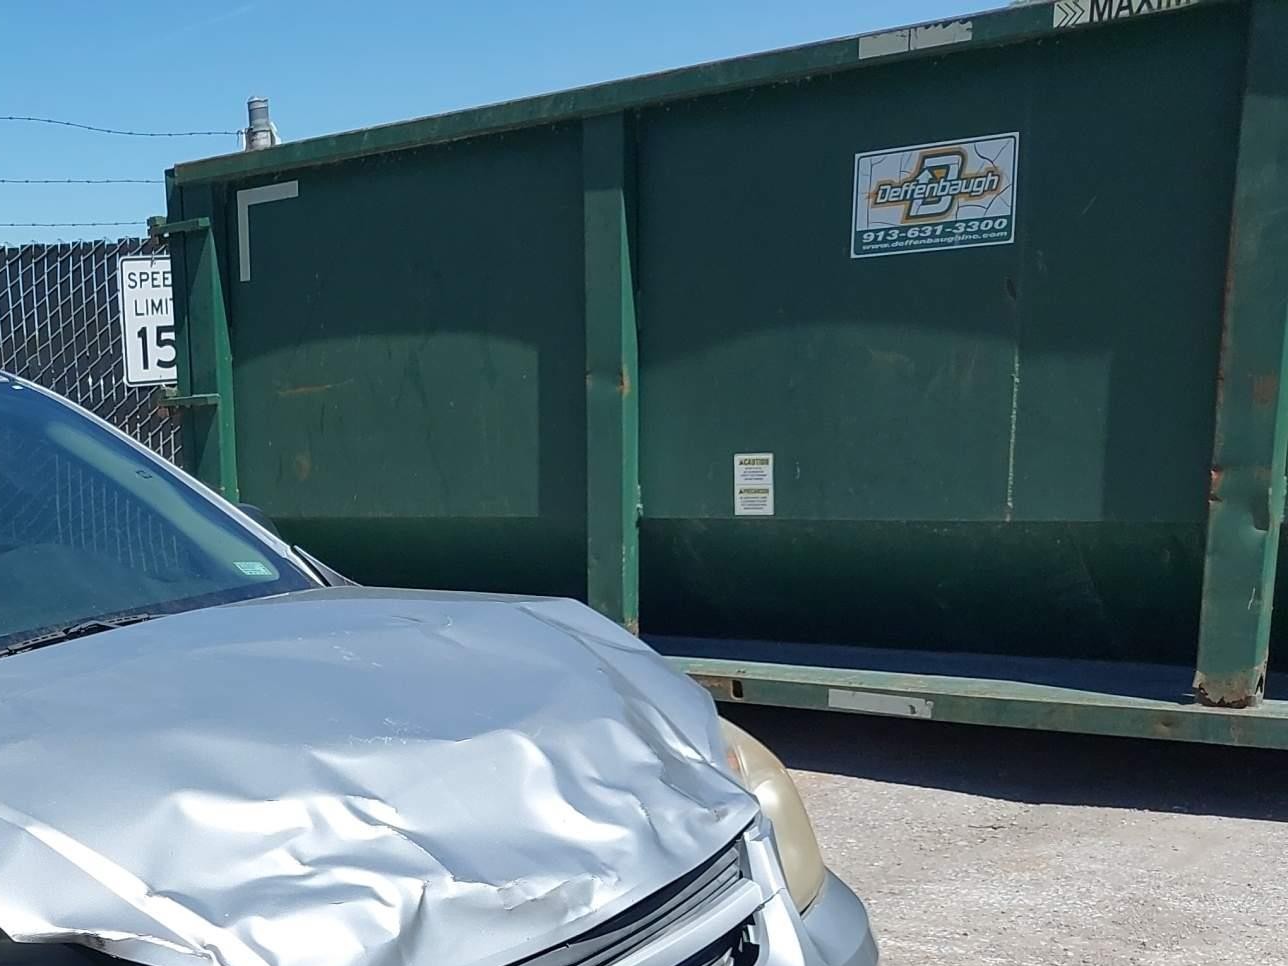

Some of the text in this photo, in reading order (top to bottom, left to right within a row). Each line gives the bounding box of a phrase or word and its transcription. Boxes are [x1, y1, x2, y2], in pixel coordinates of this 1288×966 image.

[876, 172, 999, 203] Deffenbaugh
[862, 218, 1008, 243] 913-631-3300
[127, 271, 173, 289] SPEE
[135, 298, 173, 316] LIMI
[136, 325, 177, 371] 15
